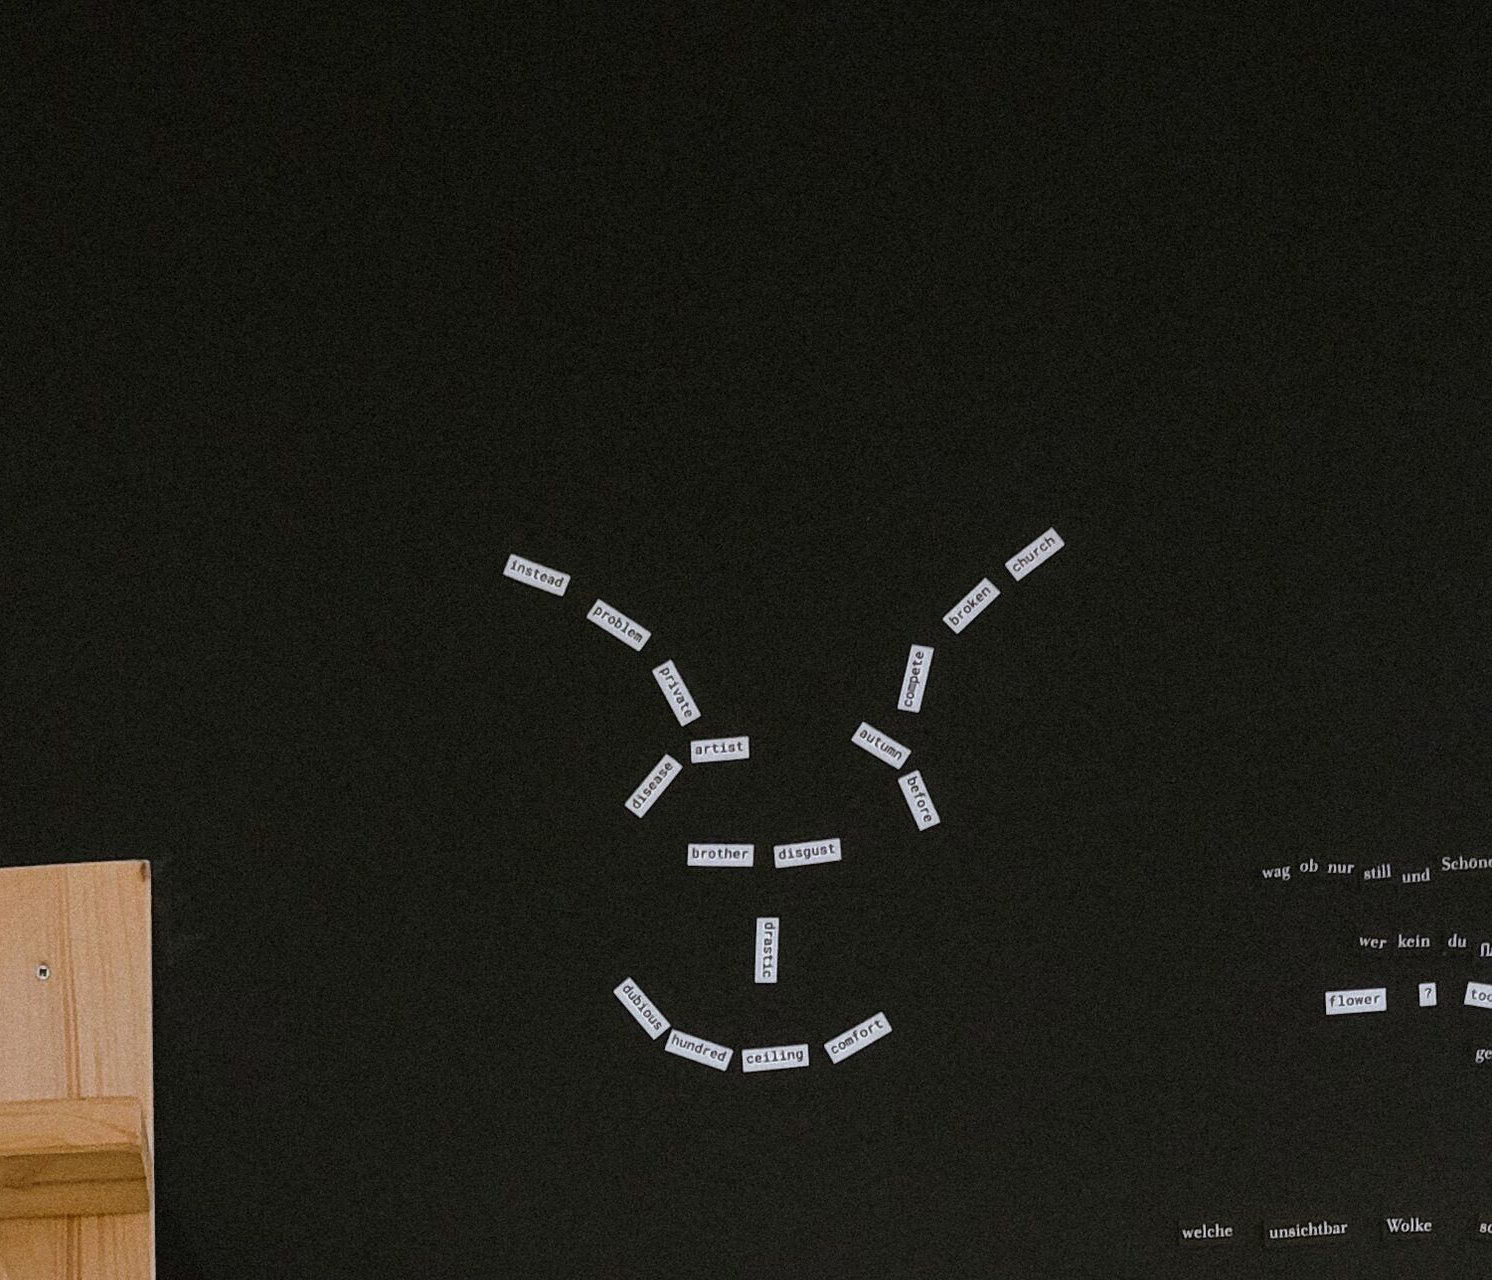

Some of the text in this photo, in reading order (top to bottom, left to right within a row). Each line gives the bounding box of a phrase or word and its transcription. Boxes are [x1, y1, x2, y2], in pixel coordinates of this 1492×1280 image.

[1011, 536, 1056, 573] church
[511, 560, 564, 587] instead
[949, 587, 990, 626] broken
[593, 607, 642, 642] problem
[659, 667, 692, 717] private
[904, 652, 924, 707] compete
[696, 742, 742, 754] artist
[859, 728, 903, 762] autumn
[633, 762, 673, 809] disease
[908, 776, 932, 822] before
[692, 844, 834, 860] brother disgust
[1262, 859, 1430, 882] wag ob nur still und
[763, 922, 776, 977] drastic
[1360, 934, 1466, 948] wer kein du
[1330, 995, 1380, 1007] flower
[621, 983, 883, 1064] dubious hundred ceiling comfort
[1183, 1218, 1431, 1238] welche unsichtbar Wolke
